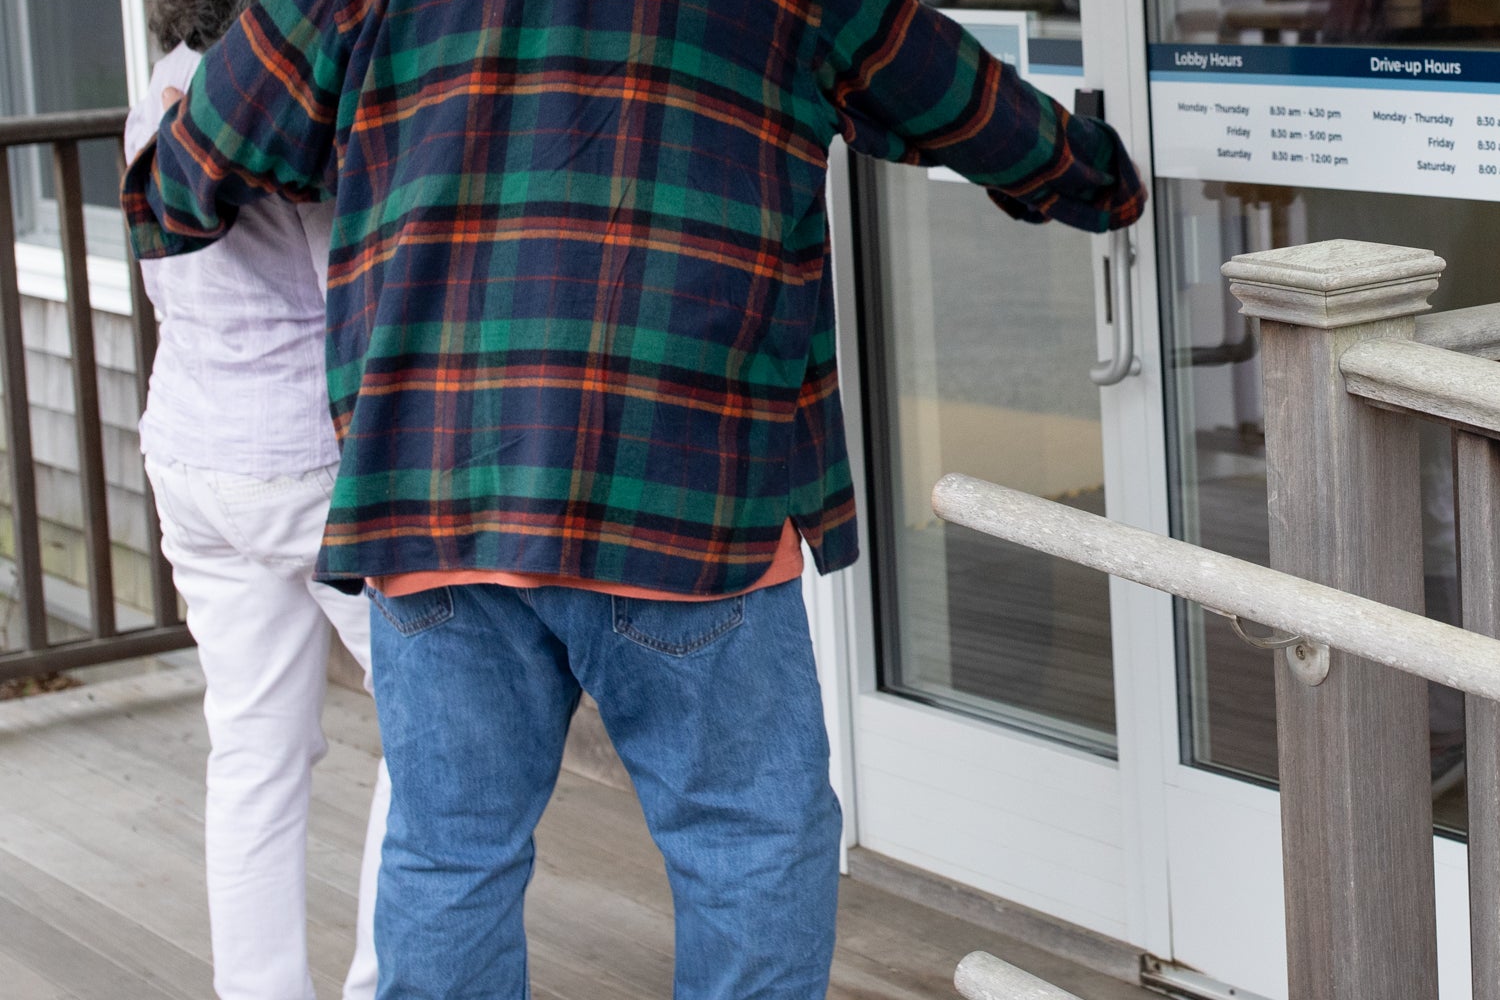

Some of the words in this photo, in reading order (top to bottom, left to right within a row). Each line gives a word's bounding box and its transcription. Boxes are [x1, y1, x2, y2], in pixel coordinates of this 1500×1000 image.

[1175, 52, 1208, 70] Lobby
[1210, 53, 1243, 67] Hours
[1370, 56, 1422, 76] Drive-up
[1425, 59, 1461, 74] Hours
[1178, 102, 1208, 114] Monday
[1215, 104, 1249, 116] Thursday
[1288, 108, 1300, 116] am
[1327, 110, 1341, 120] pm
[1373, 111, 1406, 124] Monday
[1414, 112, 1454, 126] Thursday
[1476, 116, 1494, 126] 8:30
[1226, 126, 1250, 138] Friday
[1290, 131, 1302, 139] am
[1309, 130, 1326, 141] 5:00
[1328, 133, 1342, 142] pm
[1428, 137, 1455, 150] Friday
[1478, 140, 1496, 150] 8:30
[1217, 148, 1252, 160] Saturday
[1290, 154, 1303, 162] am
[1310, 154, 1332, 164] 12:00
[1334, 156, 1348, 166] pm
[1417, 160, 1456, 174] Saturday
[1478, 164, 1497, 175] 8:00
